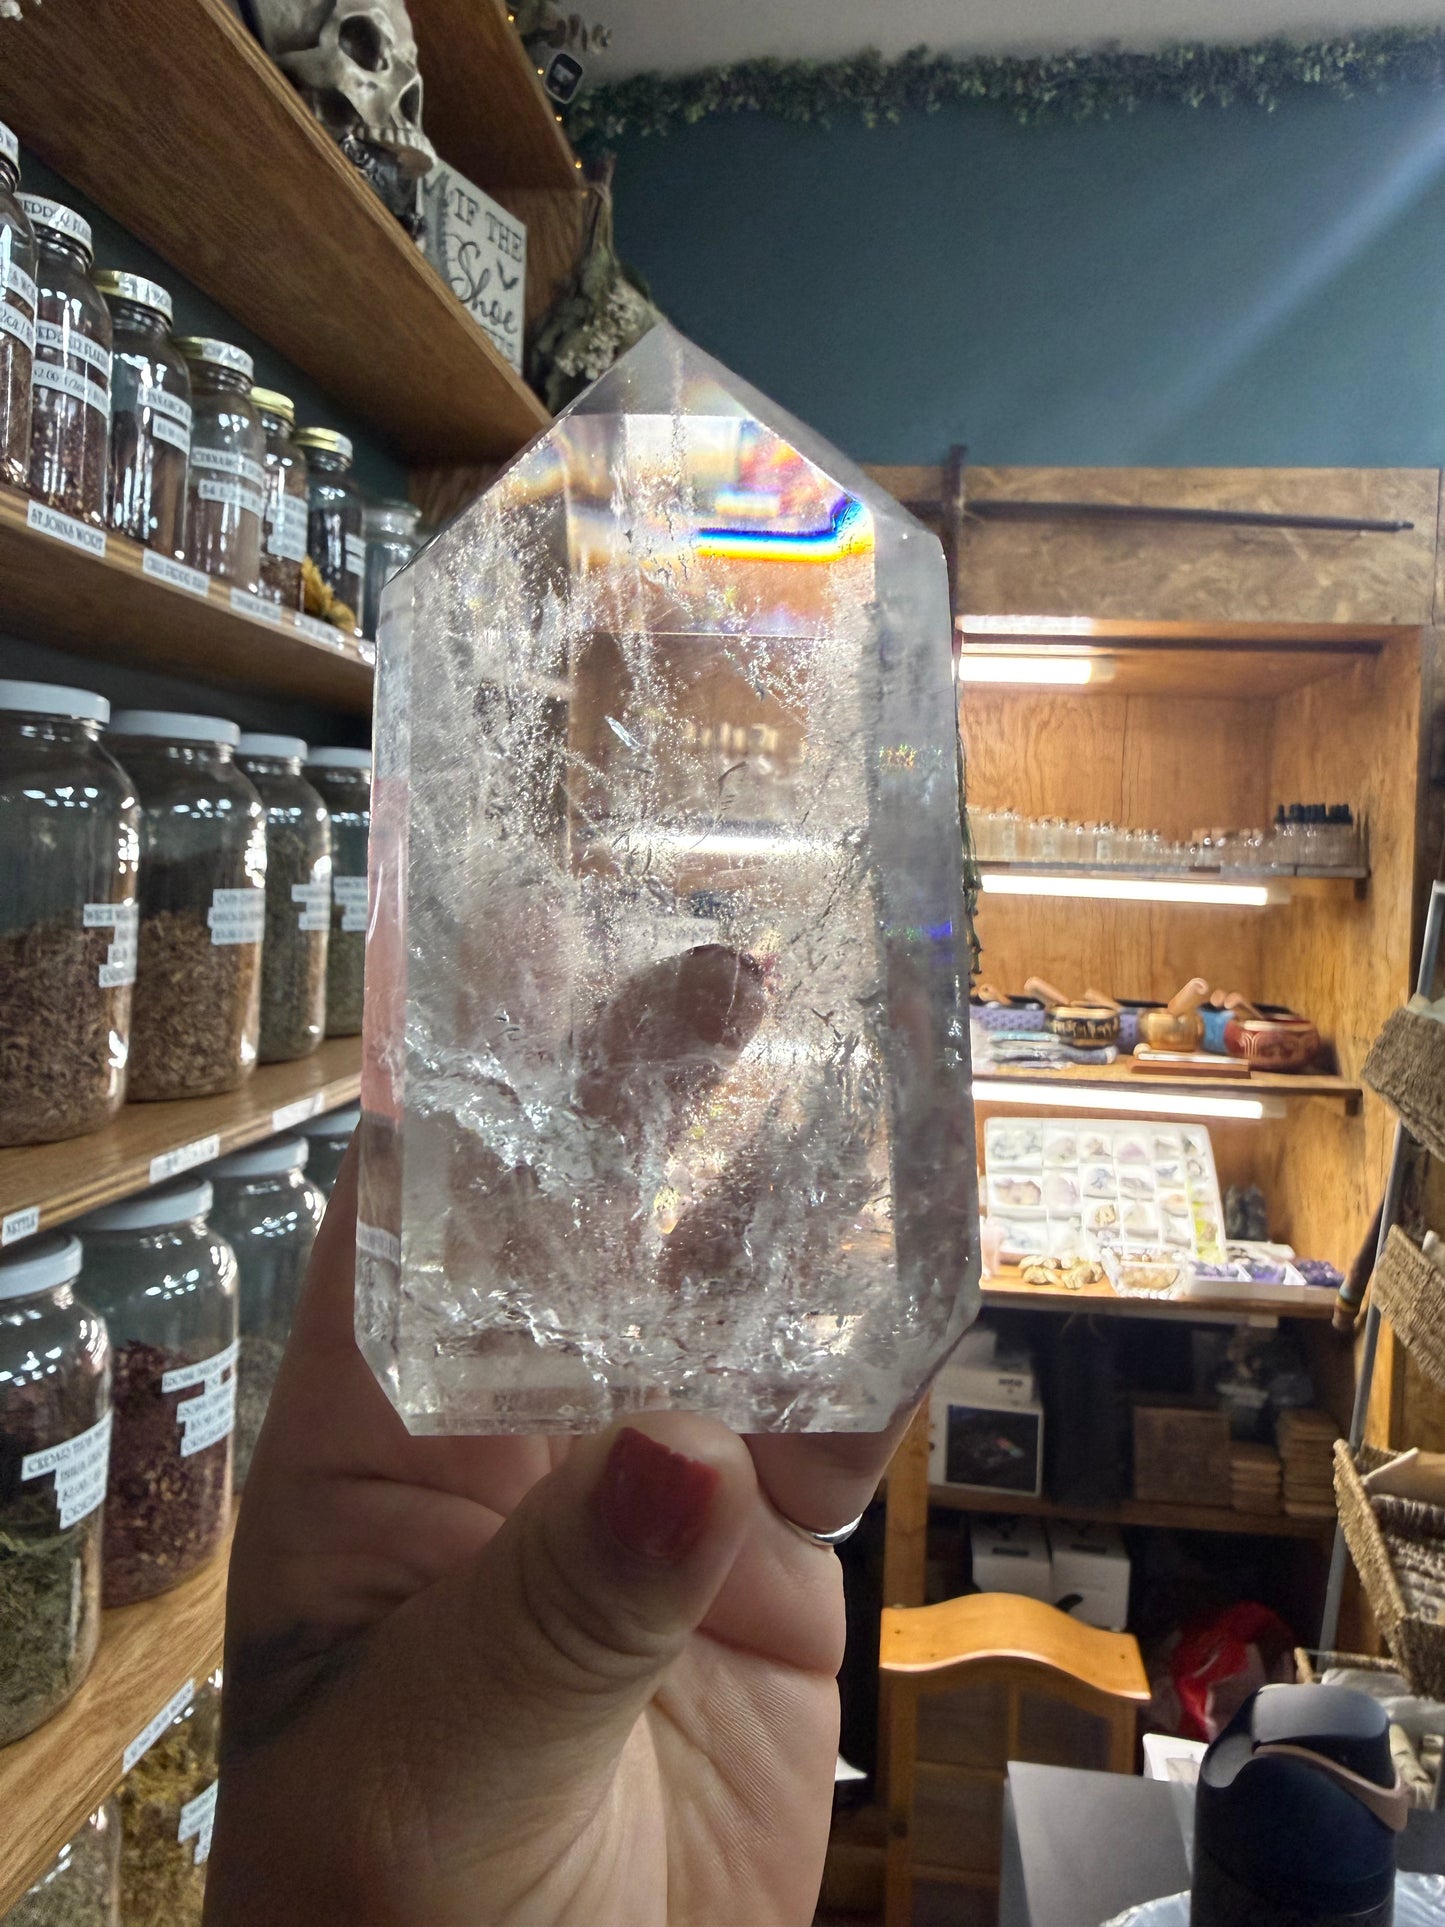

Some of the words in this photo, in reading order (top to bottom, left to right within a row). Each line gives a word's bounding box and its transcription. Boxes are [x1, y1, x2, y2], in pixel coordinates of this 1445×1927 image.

[454, 188, 478, 226] IF
[485, 210, 523, 264] THE
[449, 240, 518, 335] Shoe
